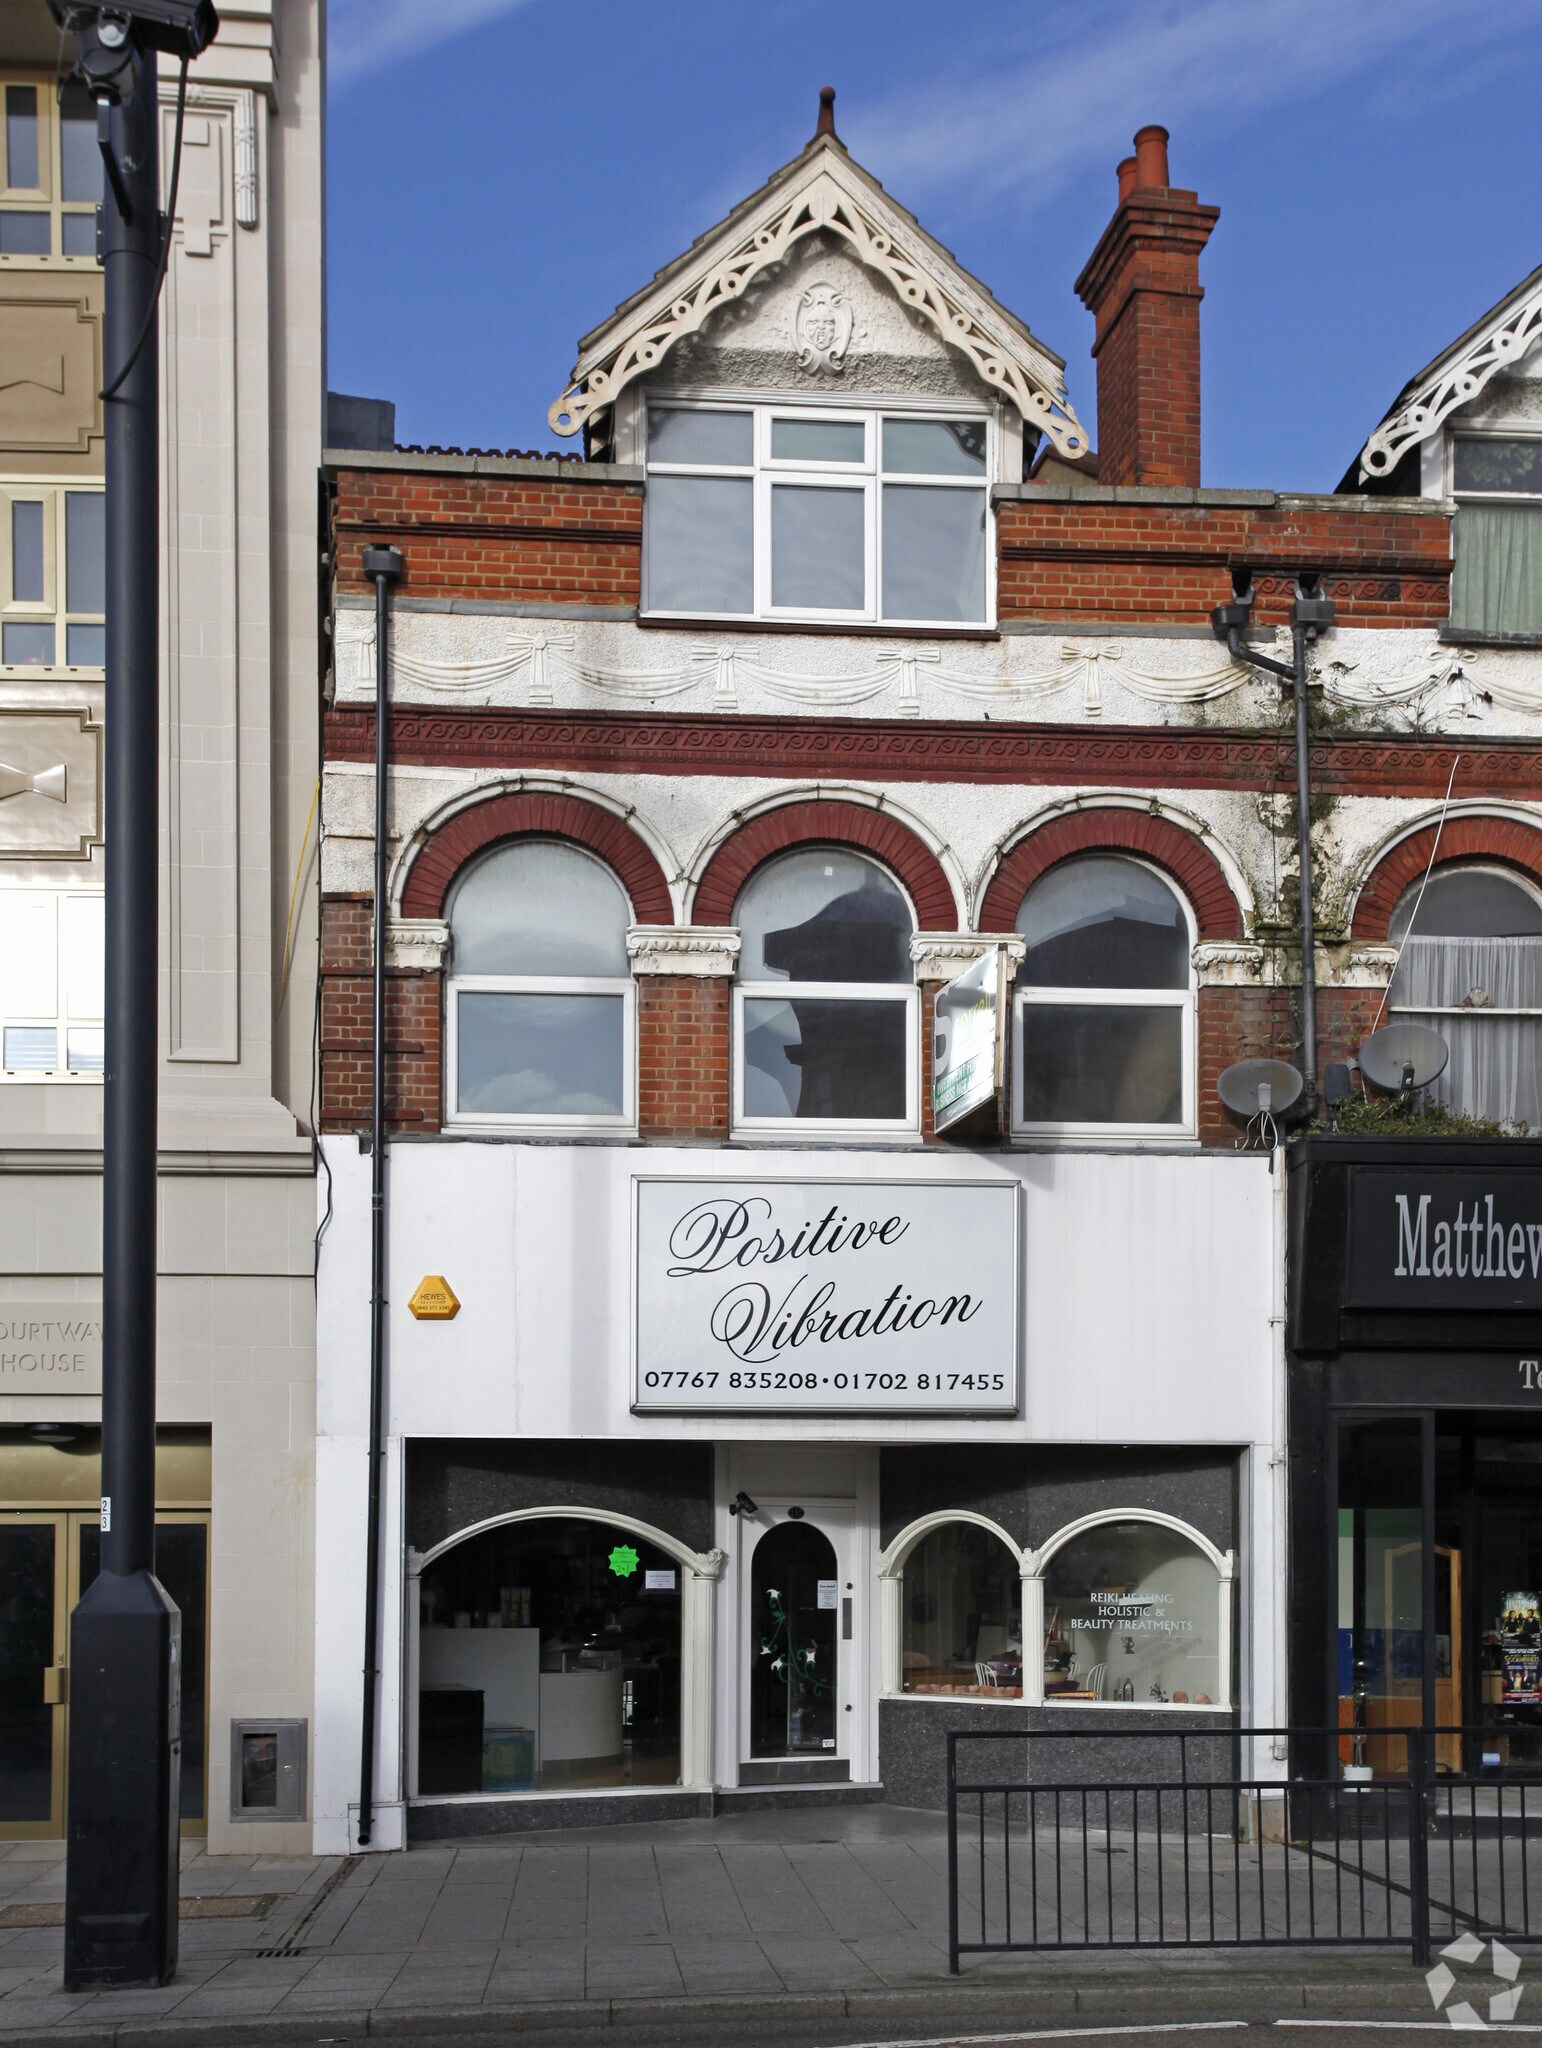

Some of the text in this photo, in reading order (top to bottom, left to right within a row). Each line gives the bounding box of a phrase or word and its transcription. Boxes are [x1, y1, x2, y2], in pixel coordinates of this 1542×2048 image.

[667, 1197, 910, 1277] Positive
[711, 1274, 983, 1363] Vibration
[2, 1353, 85, 1373] HOUSE
[645, 1371, 719, 1388] 07767
[918, 1373, 1004, 1391] 817455
[102, 1500, 107, 1512] 2
[101, 1516, 107, 1529] 3
[1090, 1592, 1119, 1603] REIKI
[1098, 1605, 1165, 1617] HOLISTIC &
[1071, 1618, 1193, 1630] BEAUTY TREATMENTS
